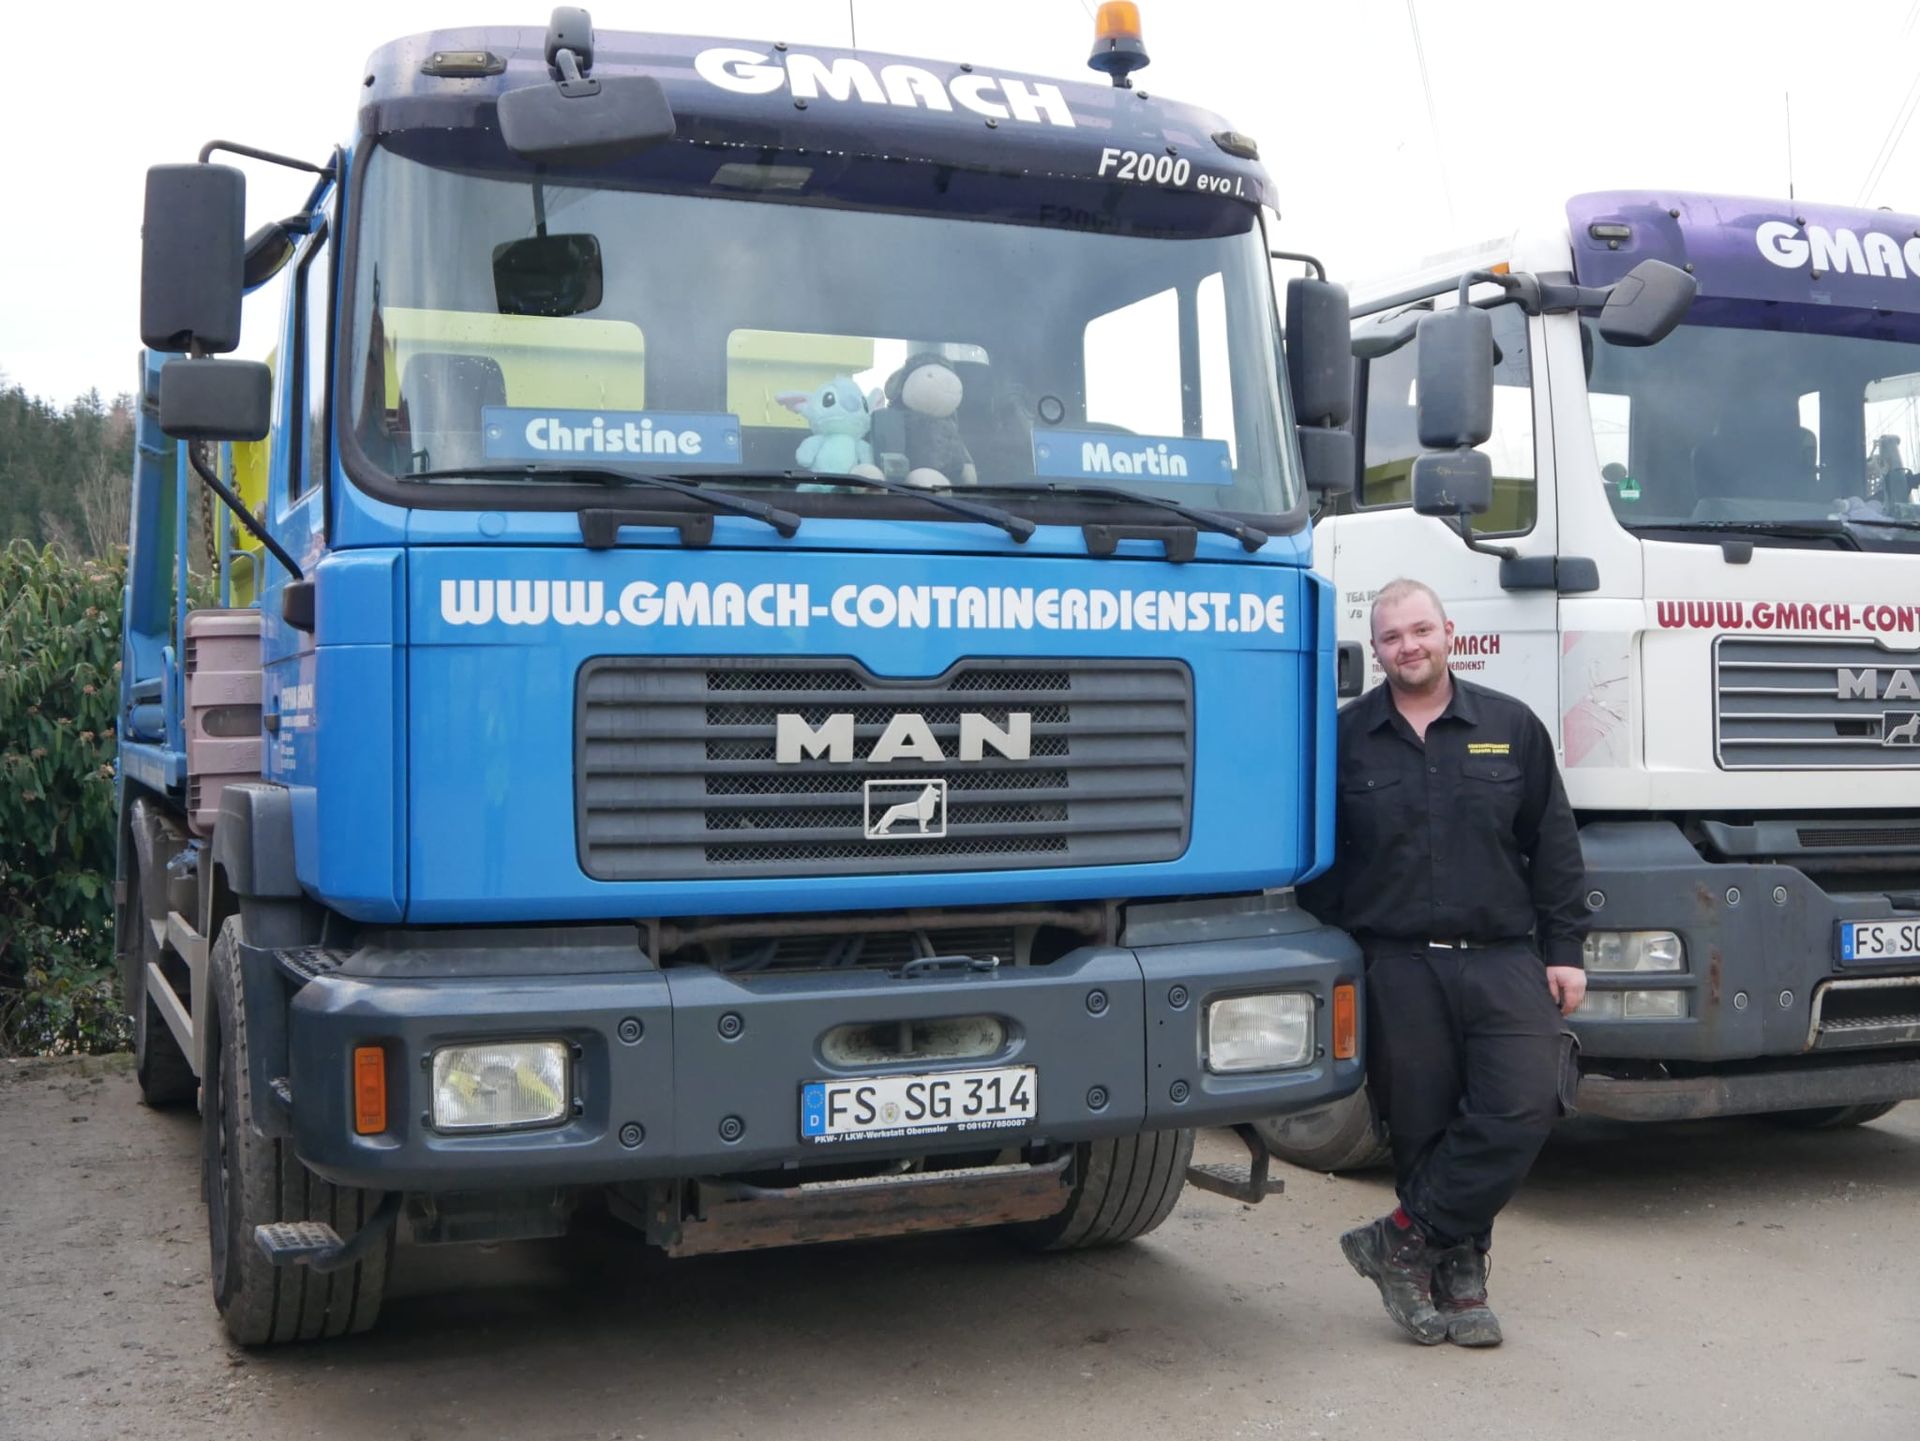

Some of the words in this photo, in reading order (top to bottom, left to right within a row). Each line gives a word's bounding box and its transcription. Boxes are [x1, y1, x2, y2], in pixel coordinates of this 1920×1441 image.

[694, 47, 1076, 128] GMACH
[1098, 147, 1190, 186] F2000
[1197, 173, 1231, 194] evo
[525, 416, 702, 455] Christine
[1081, 442, 1188, 477] Martin
[776, 712, 1031, 763] MAN
[1856, 927, 1884, 954] FS
[810, 1115, 819, 1126] D
[828, 1086, 876, 1127] FS
[905, 1080, 951, 1120] SG
[962, 1075, 1029, 1116] 314
[815, 1134, 838, 1144] PKW-
[845, 1127, 905, 1141] LKW-Werkstatt
